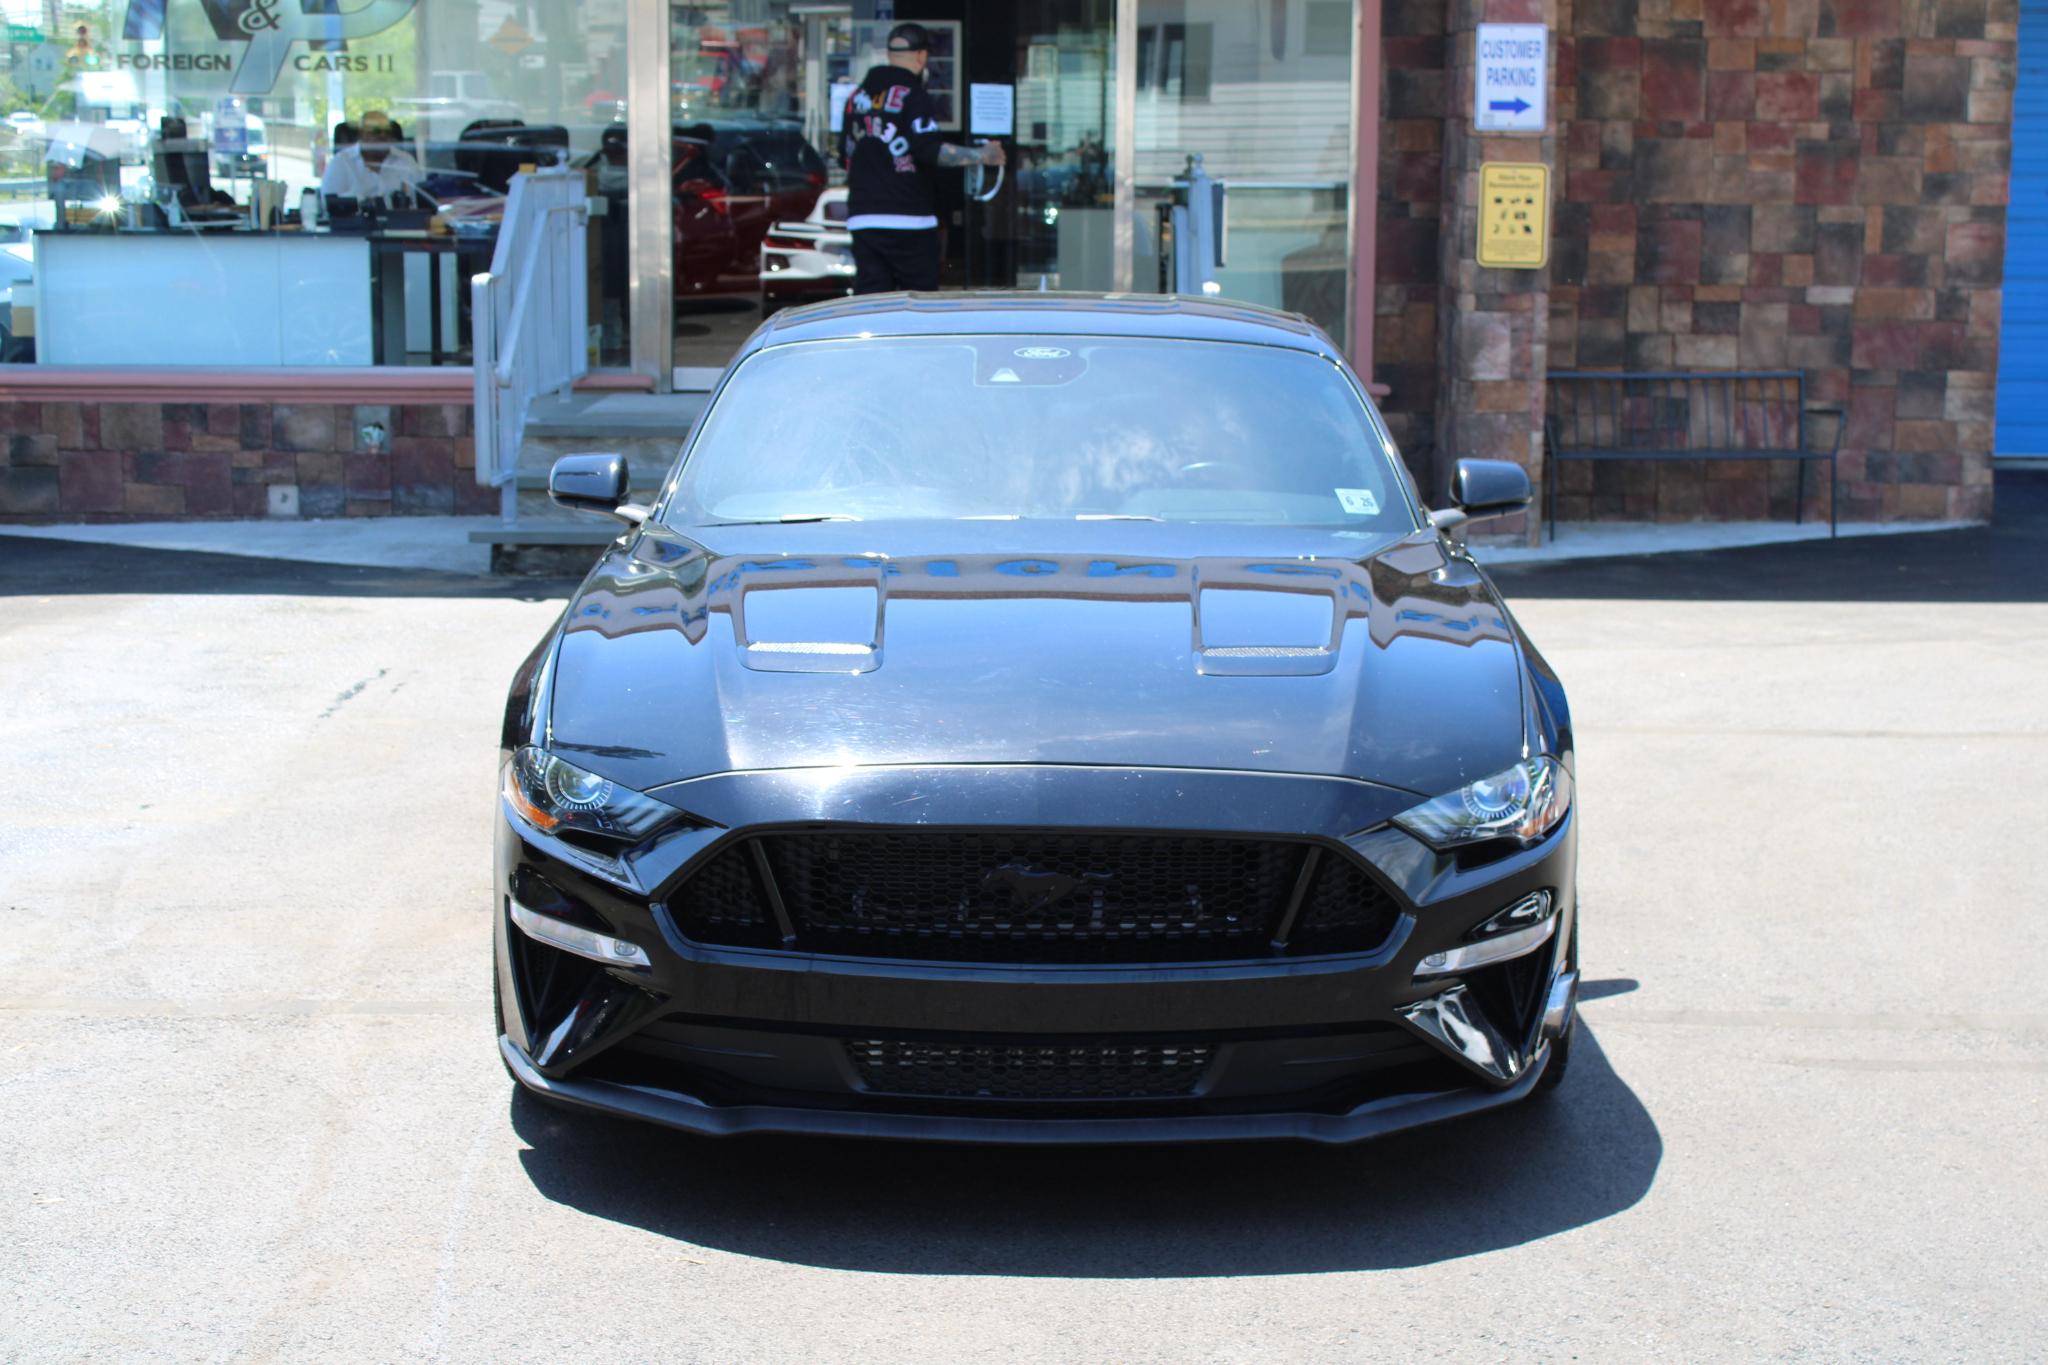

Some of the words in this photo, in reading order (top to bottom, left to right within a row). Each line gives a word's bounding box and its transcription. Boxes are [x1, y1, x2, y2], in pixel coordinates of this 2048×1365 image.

[1481, 40, 1541, 59] CUSTOMER
[117, 54, 232, 72] FOREIGN
[293, 54, 369, 72] CARS
[1486, 67, 1536, 87] PARKING
